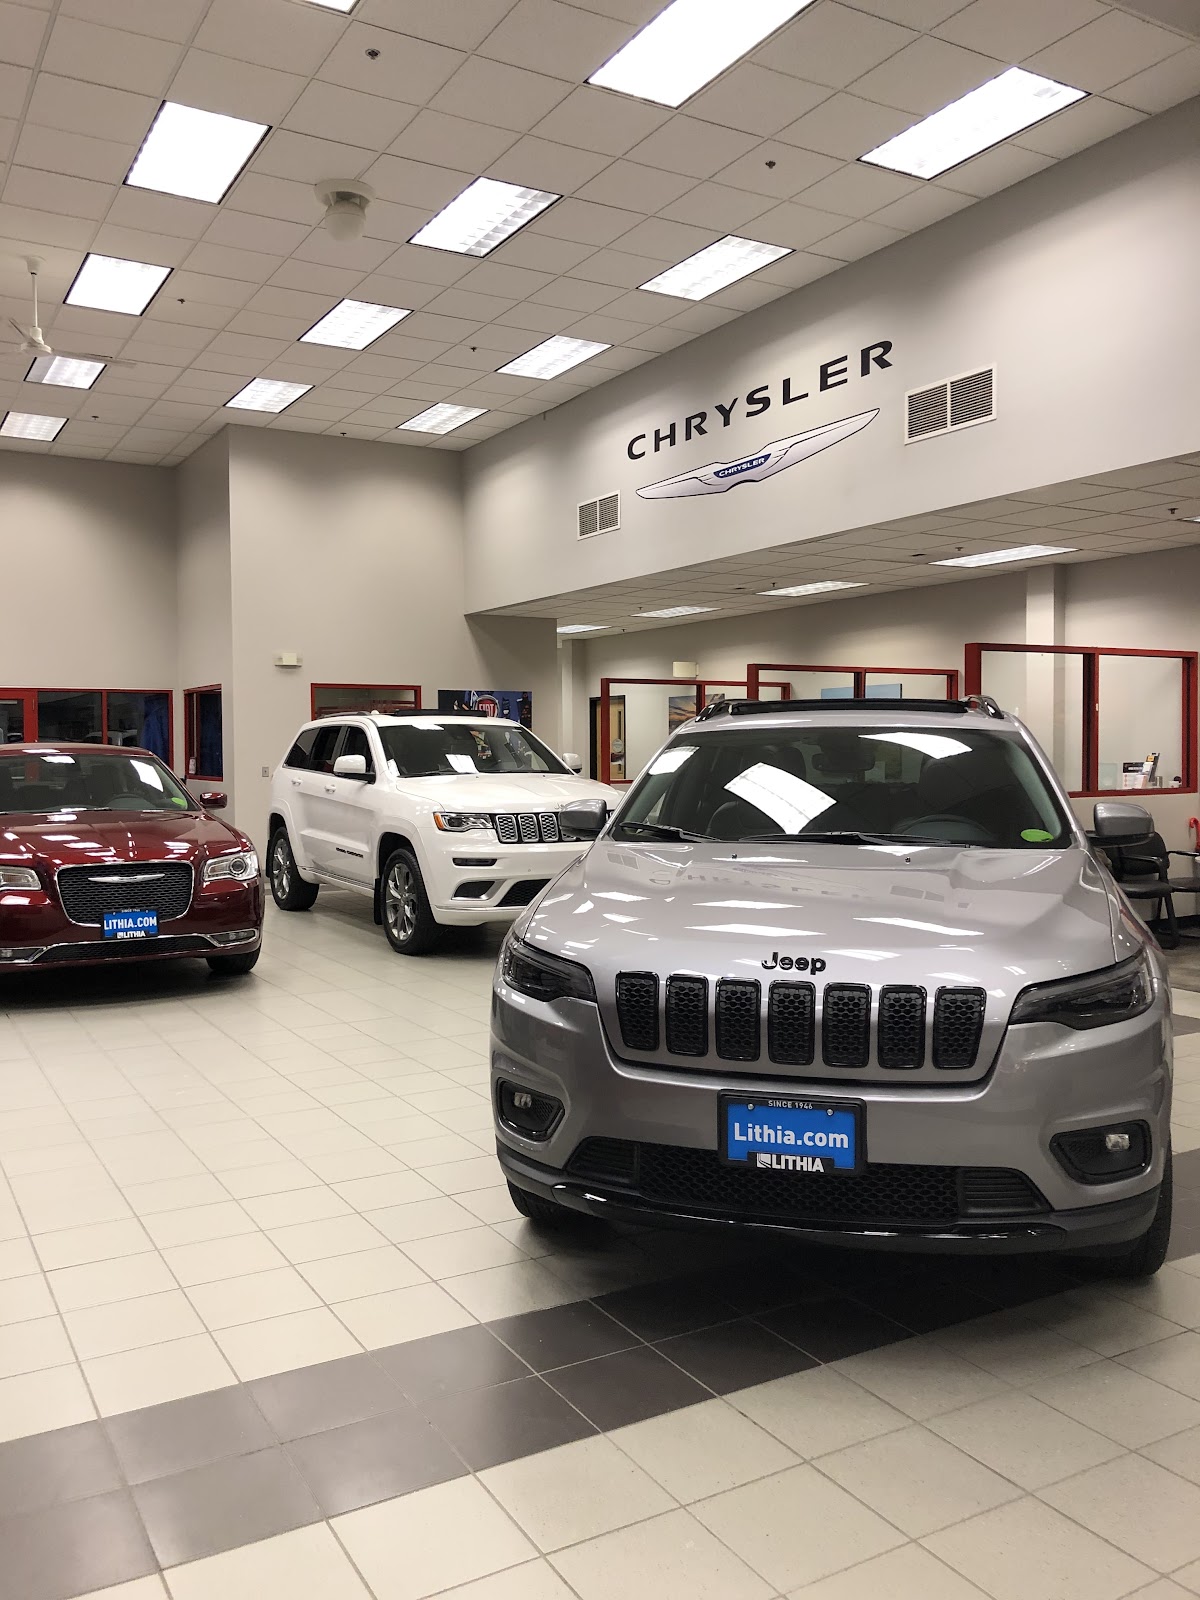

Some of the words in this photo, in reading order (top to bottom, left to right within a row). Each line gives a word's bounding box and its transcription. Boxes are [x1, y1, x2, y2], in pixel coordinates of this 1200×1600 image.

[627, 340, 892, 460] CHRYSLER
[719, 457, 765, 476] CHRYSLER
[104, 916, 157, 930] LITHIA.COM
[123, 930, 146, 938] LITHIA
[761, 952, 827, 975] Jeep
[767, 1100, 792, 1109] SINCE
[794, 1102, 813, 1110] 1946
[735, 1122, 849, 1148] Lithia.com
[771, 1154, 825, 1173] LITHIA
